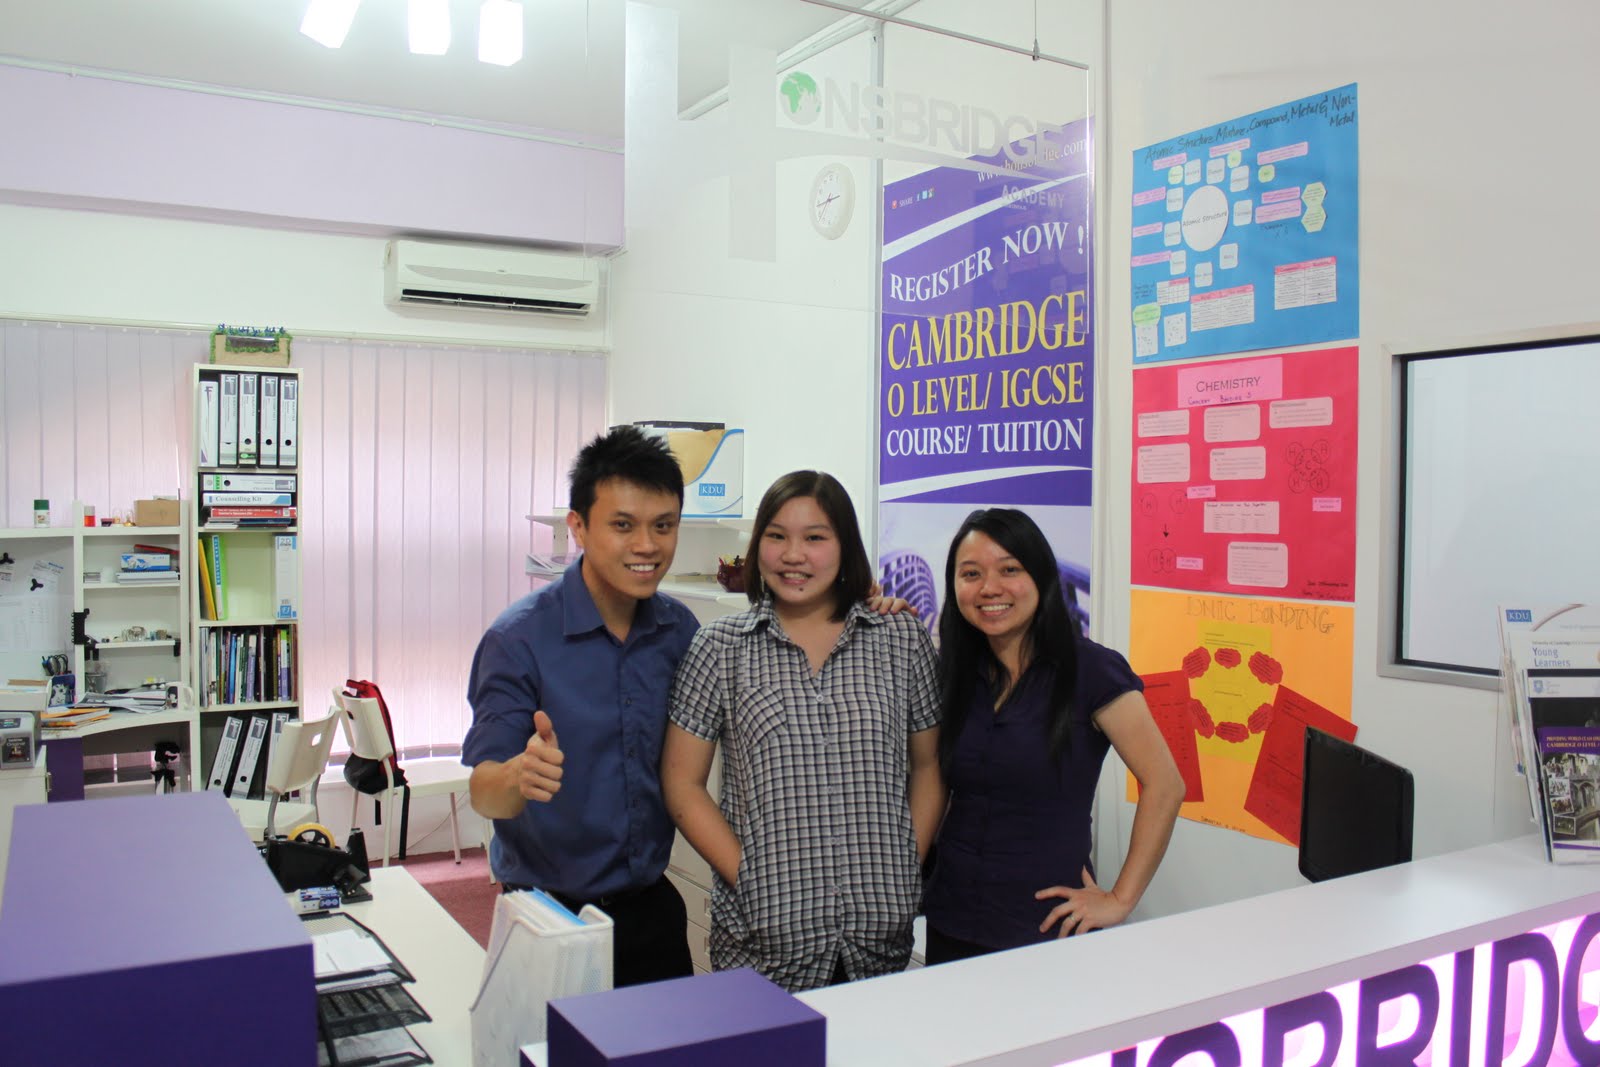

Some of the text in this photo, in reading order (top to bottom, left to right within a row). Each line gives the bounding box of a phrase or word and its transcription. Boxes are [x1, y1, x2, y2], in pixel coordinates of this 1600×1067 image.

[1329, 112, 1355, 128] Metal
[1001, 184, 1065, 208] ACADEMY
[890, 246, 994, 302] REGISTER
[1001, 221, 1070, 264] NOW
[887, 290, 1085, 370] CAMBRIDGE
[887, 361, 1084, 417] O LEVEL/ IGCSE
[1196, 376, 1261, 393] CHEMISTRY
[886, 418, 1084, 456] COURSE/ TUITION
[702, 486, 723, 494] KDU
[1509, 612, 1530, 620] KDU
[1532, 647, 1558, 658] Young
[1534, 658, 1571, 667] Learners
